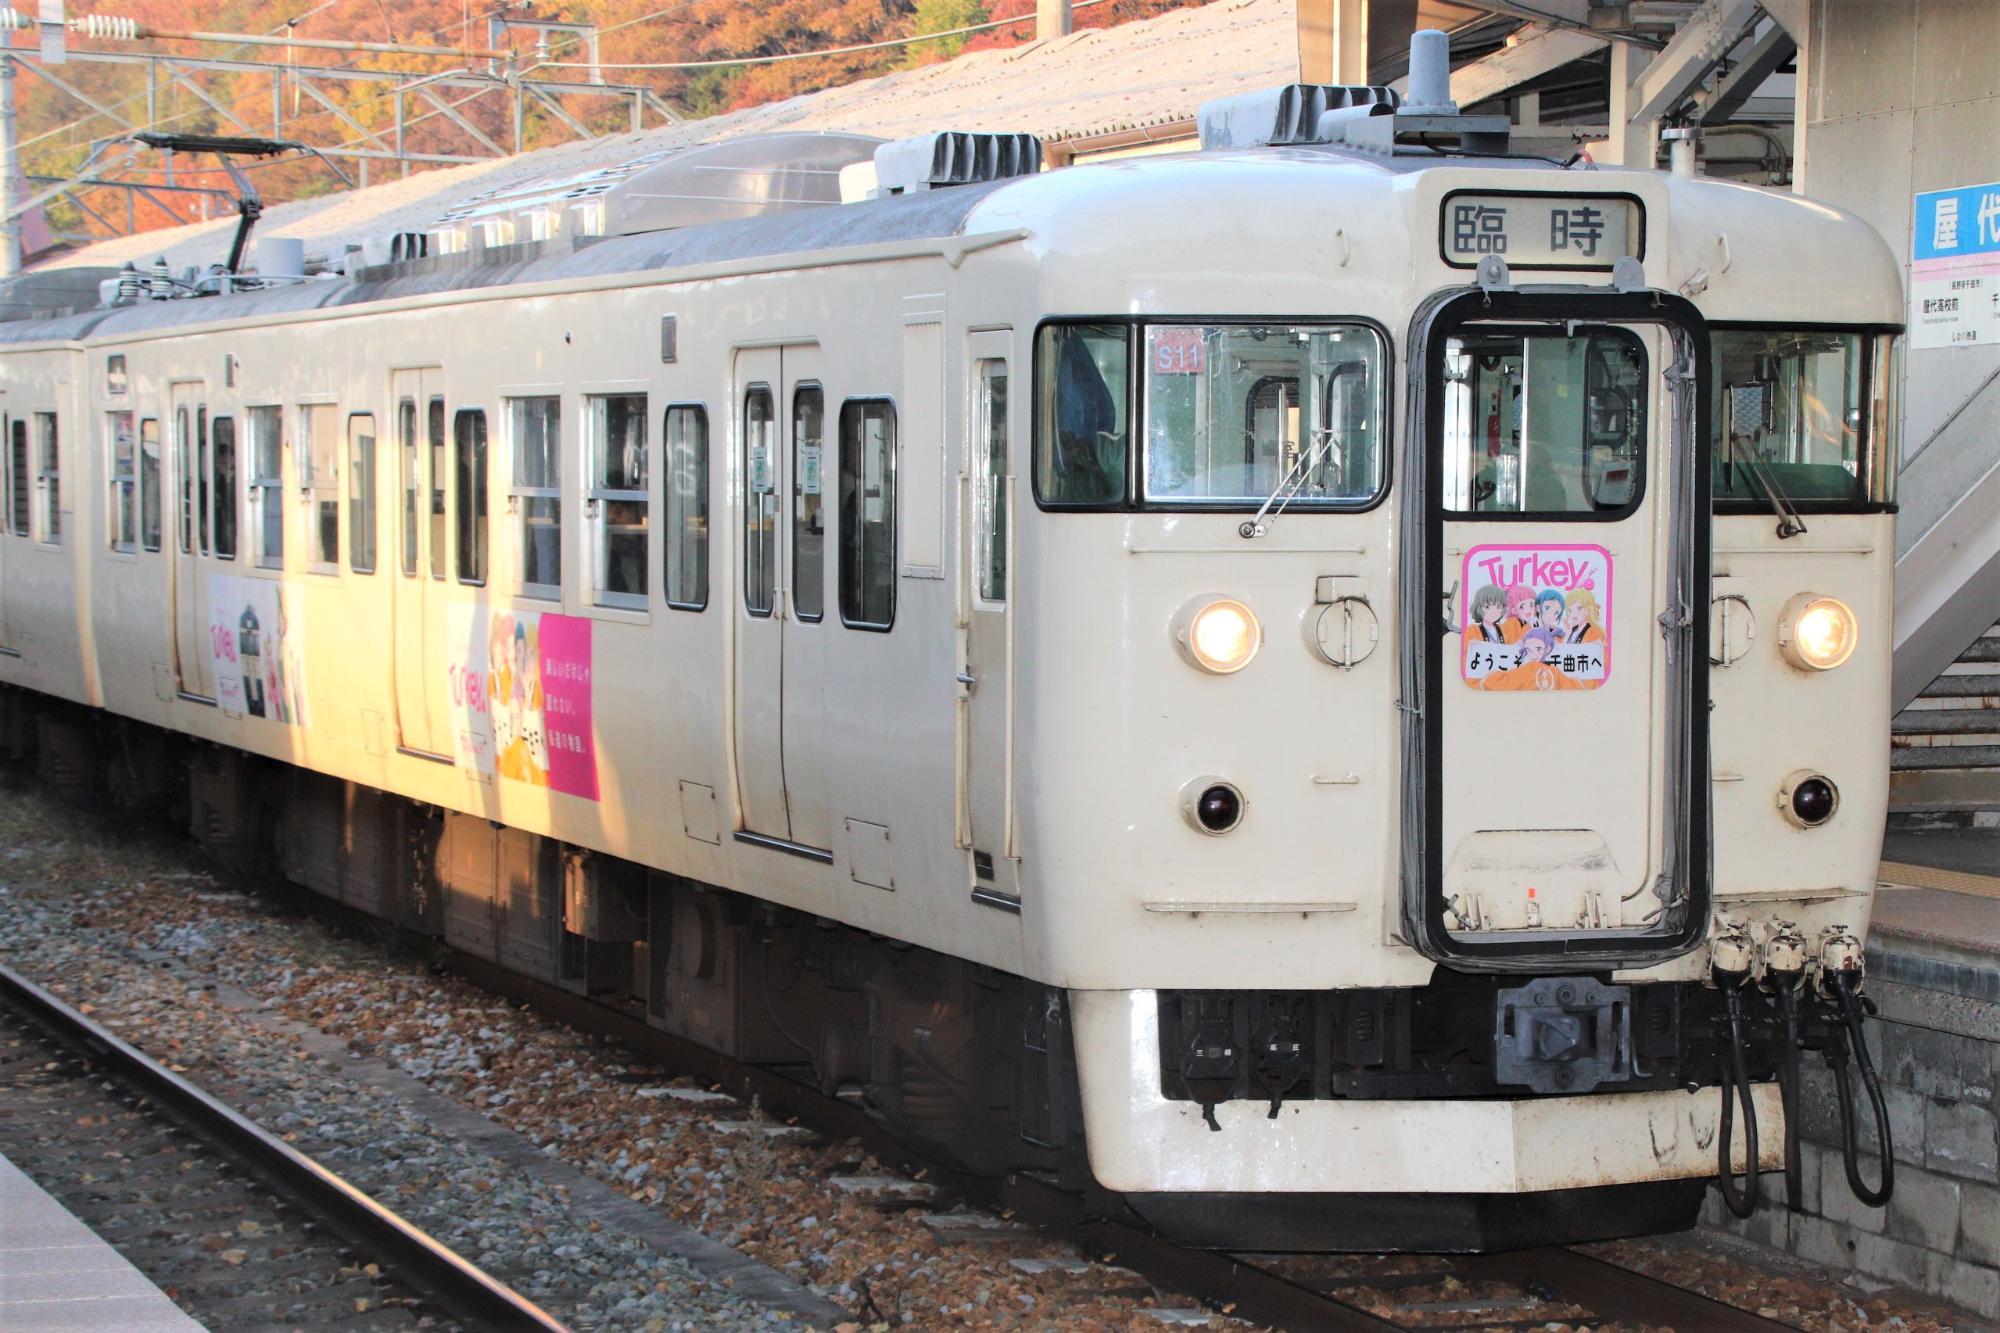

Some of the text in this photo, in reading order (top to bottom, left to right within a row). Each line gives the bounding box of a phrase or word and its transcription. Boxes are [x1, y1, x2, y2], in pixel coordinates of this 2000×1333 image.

[1454, 205, 1604, 257] 臨時
[1923, 297, 1959, 314] 屋代高校前
[1159, 345, 1198, 369] S11
[1543, 654, 1602, 673] 千曲市へ
